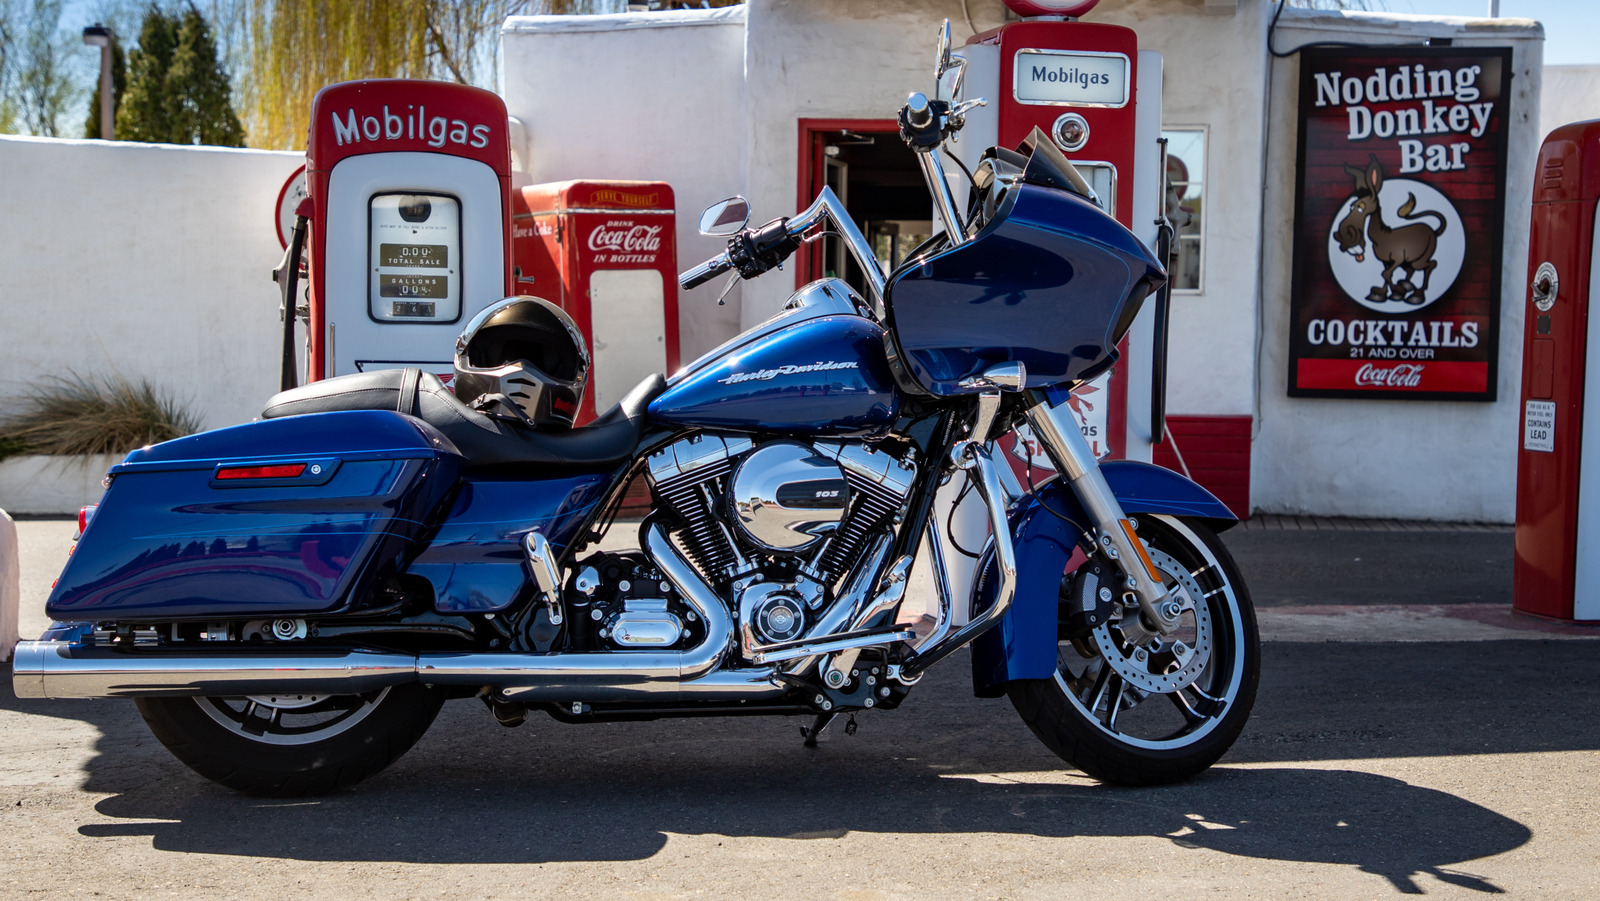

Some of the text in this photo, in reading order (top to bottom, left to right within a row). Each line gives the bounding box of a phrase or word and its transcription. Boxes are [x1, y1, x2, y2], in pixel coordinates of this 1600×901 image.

[1032, 66, 1109, 89] Mobilgas
[1314, 64, 1481, 107] Nodding
[331, 104, 491, 148] Mobilgas
[1346, 100, 1493, 139] Donkey
[1398, 139, 1470, 174] Bar
[587, 224, 663, 251] Coca-Cola
[593, 254, 656, 263] IN BOTTLES
[1307, 319, 1478, 348] COCKTAILS
[1350, 347, 1435, 359] 21 AND OVER
[718, 361, 859, 385] Harley-Davidson
[1355, 362, 1425, 387] Coca-Cola
[1528, 419, 1551, 428] CONTAINS
[1530, 430, 1547, 440] LEAD
[815, 490, 839, 498] 103
